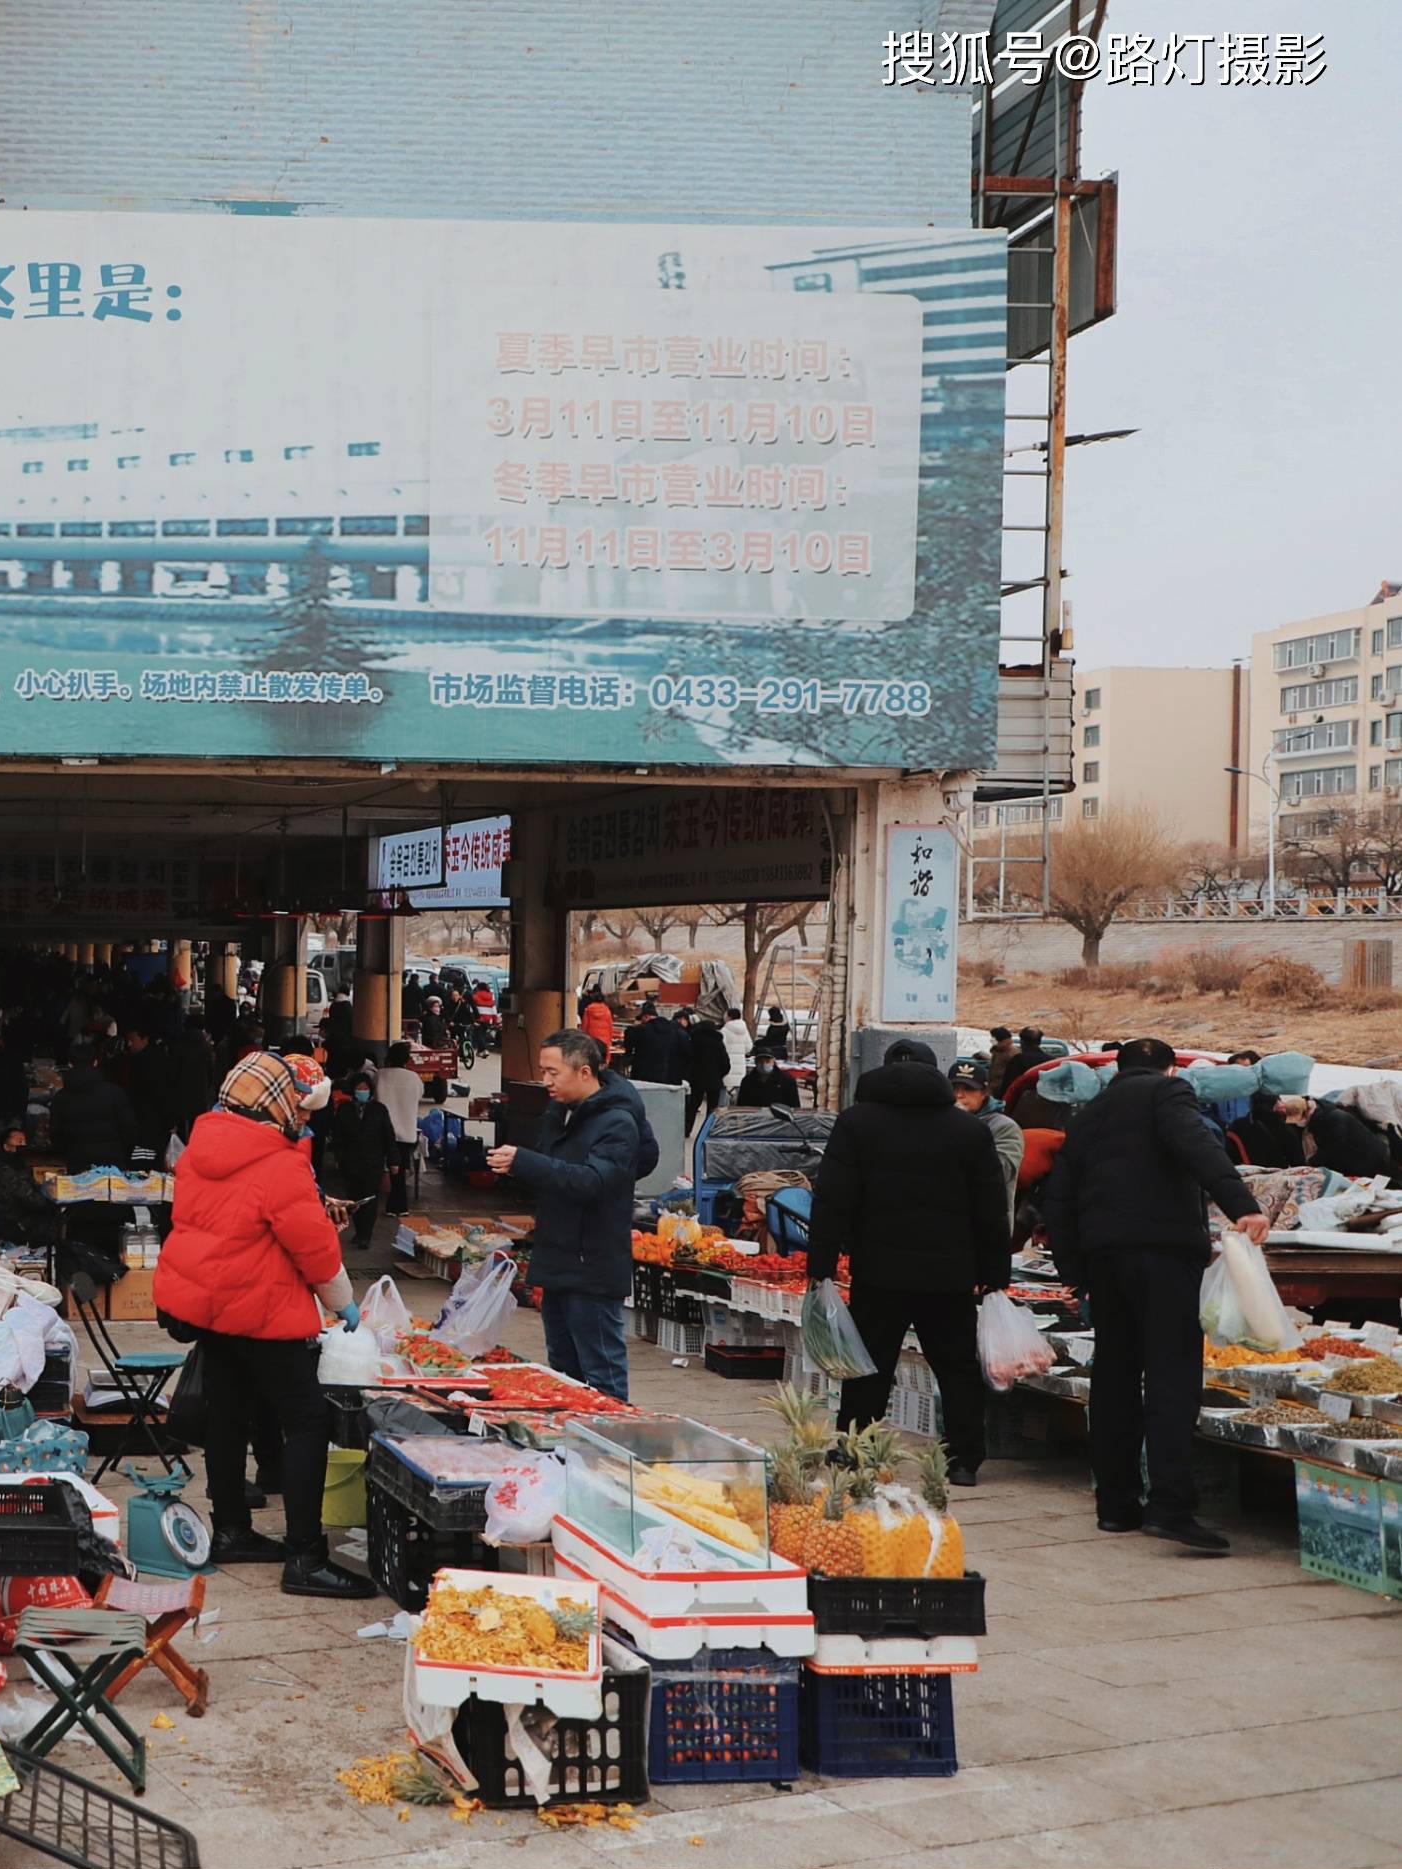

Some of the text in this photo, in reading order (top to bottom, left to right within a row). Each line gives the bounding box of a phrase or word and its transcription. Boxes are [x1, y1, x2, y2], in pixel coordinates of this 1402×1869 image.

[486, 396, 877, 447] 3月11日至11月10日
[483, 526, 873, 576] 11月11日至3月10日
[909, 836, 934, 897] 和谐
